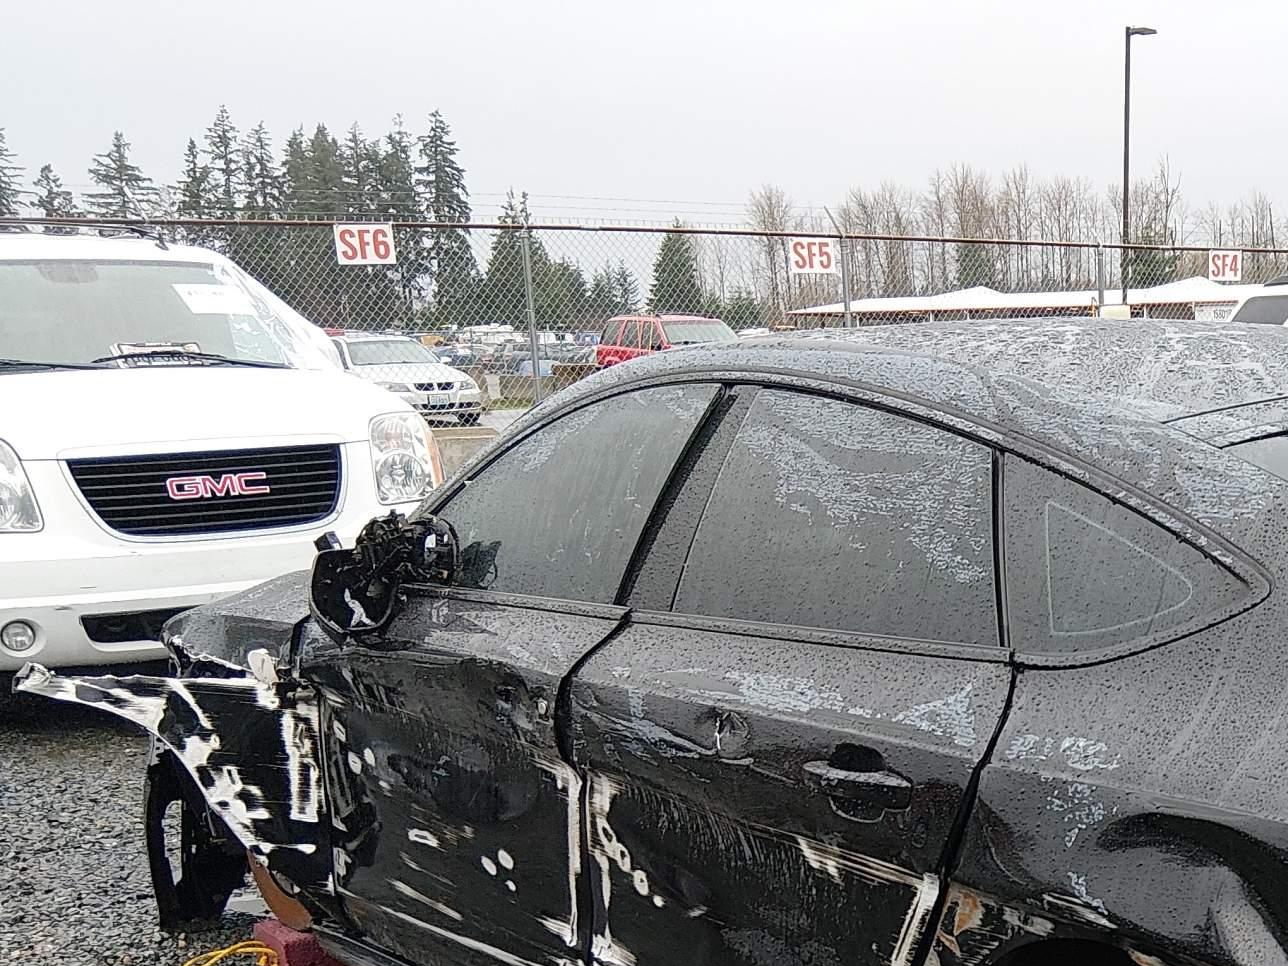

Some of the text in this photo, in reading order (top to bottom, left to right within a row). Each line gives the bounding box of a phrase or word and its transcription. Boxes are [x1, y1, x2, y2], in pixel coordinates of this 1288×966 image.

[339, 228, 391, 260] SF6
[793, 241, 831, 269] SF5
[1211, 254, 1239, 277] SF4
[166, 472, 270, 500] GMC
